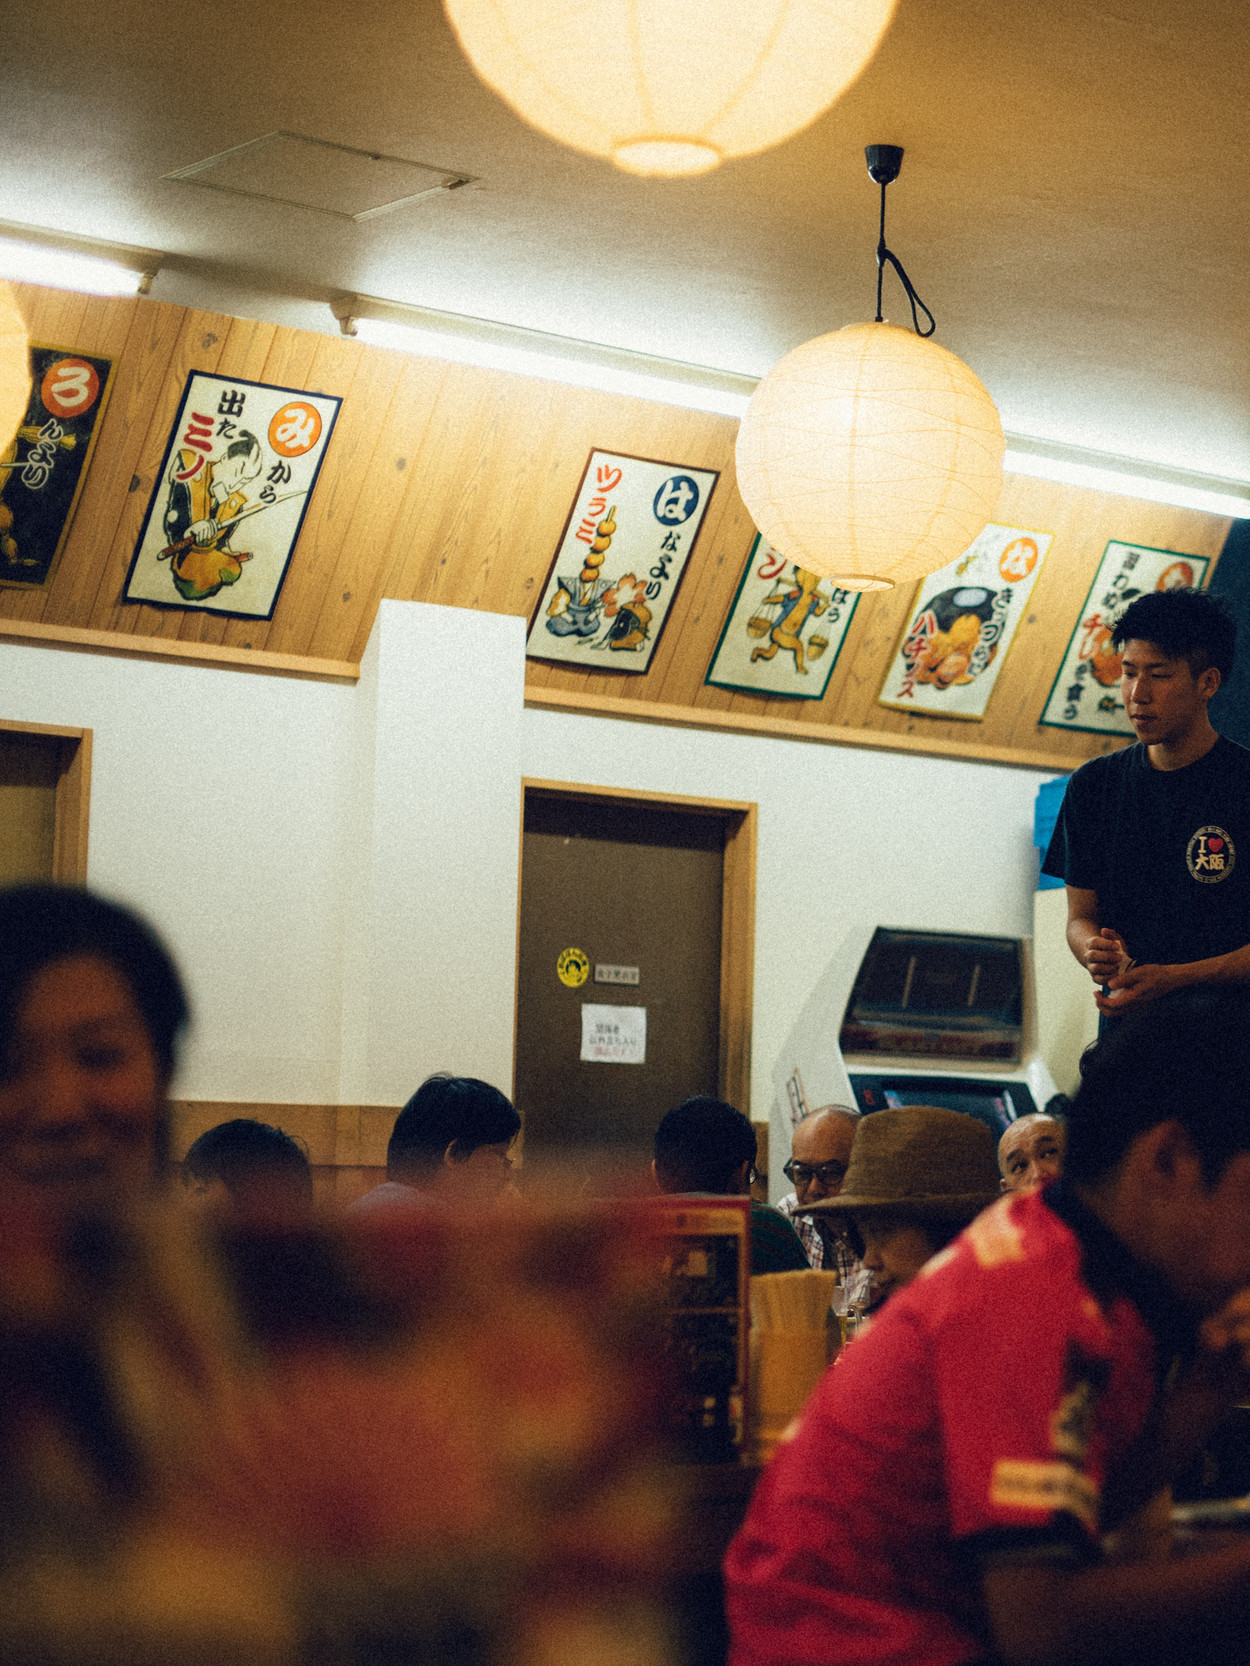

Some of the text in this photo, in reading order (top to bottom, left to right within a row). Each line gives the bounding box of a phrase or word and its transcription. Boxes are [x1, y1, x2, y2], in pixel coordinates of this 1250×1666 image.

[575, 464, 622, 545] ツラミ
[1198, 836, 1208, 853] I
[1195, 853, 1225, 871] 大阪
